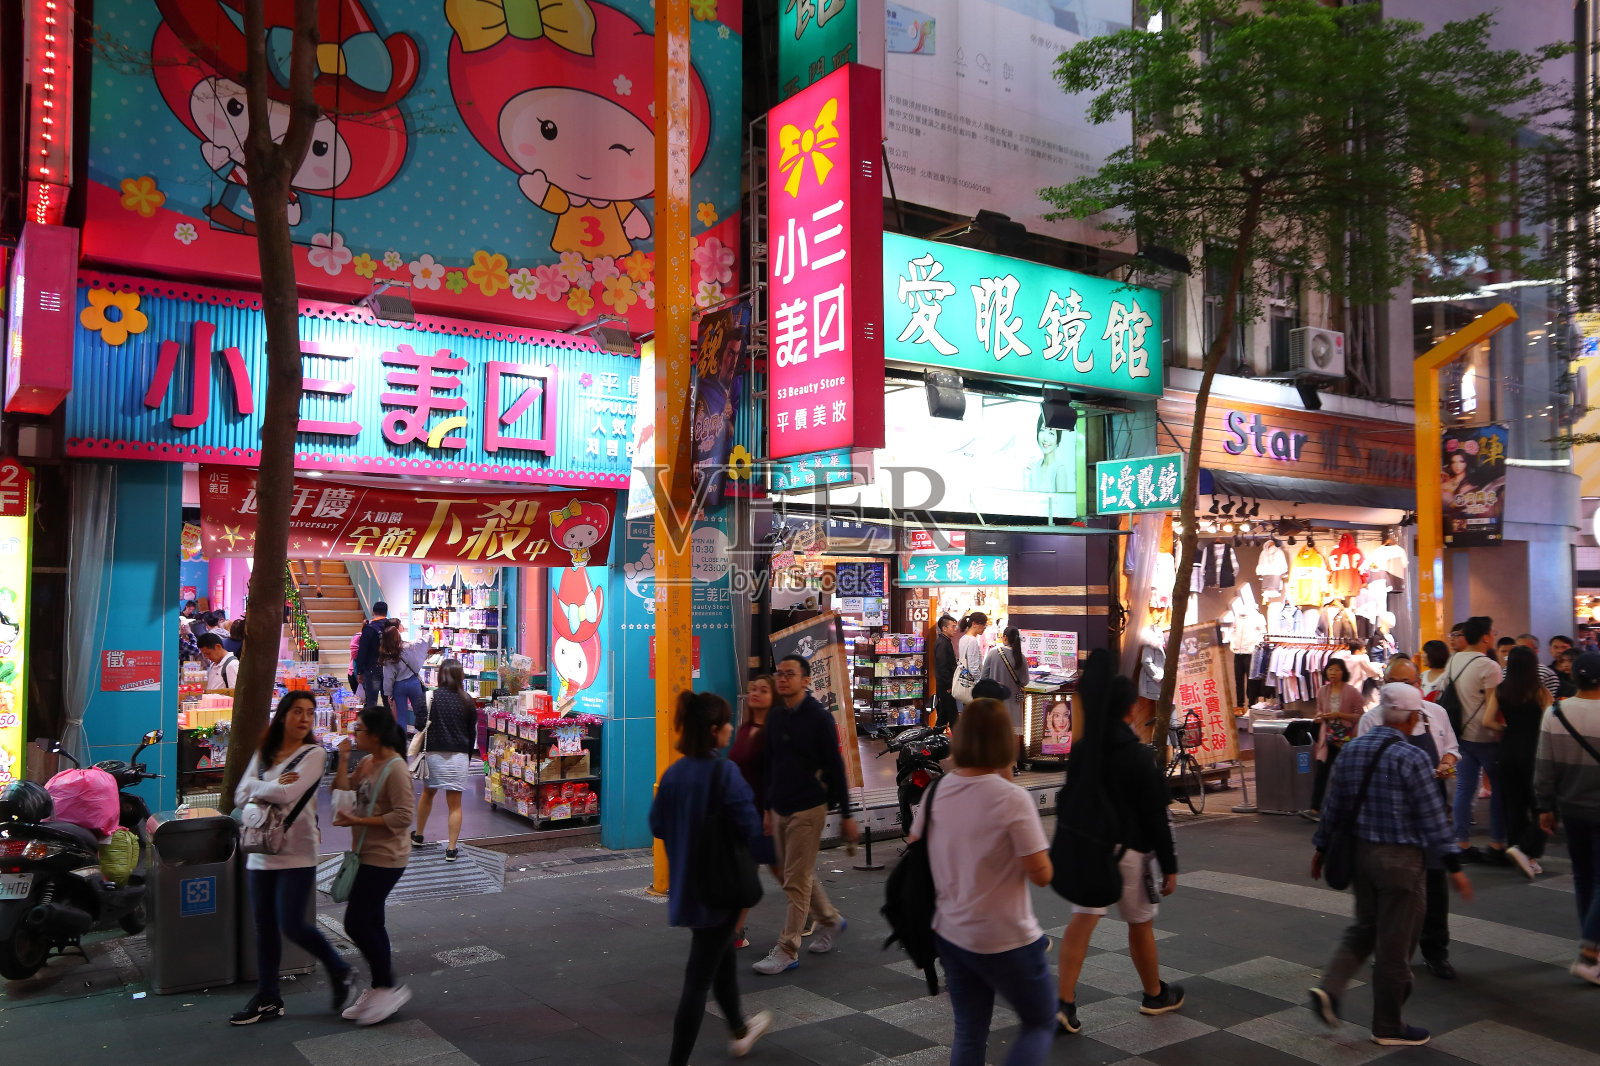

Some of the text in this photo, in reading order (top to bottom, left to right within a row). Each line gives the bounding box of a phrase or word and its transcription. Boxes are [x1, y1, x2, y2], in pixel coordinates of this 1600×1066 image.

[580, 216, 605, 247] 3
[774, 199, 847, 285] 小三
[897, 252, 1154, 379] 愛眼鏡館
[777, 374, 846, 400] S3 Beauty Store
[776, 399, 848, 433] 平價美妝
[1223, 409, 1308, 462] Star
[1, 465, 19, 487] 2
[657, 549, 665, 566] H
[656, 587, 668, 603] 29
[693, 588, 731, 602] 三美日
[914, 608, 929, 621] 65
